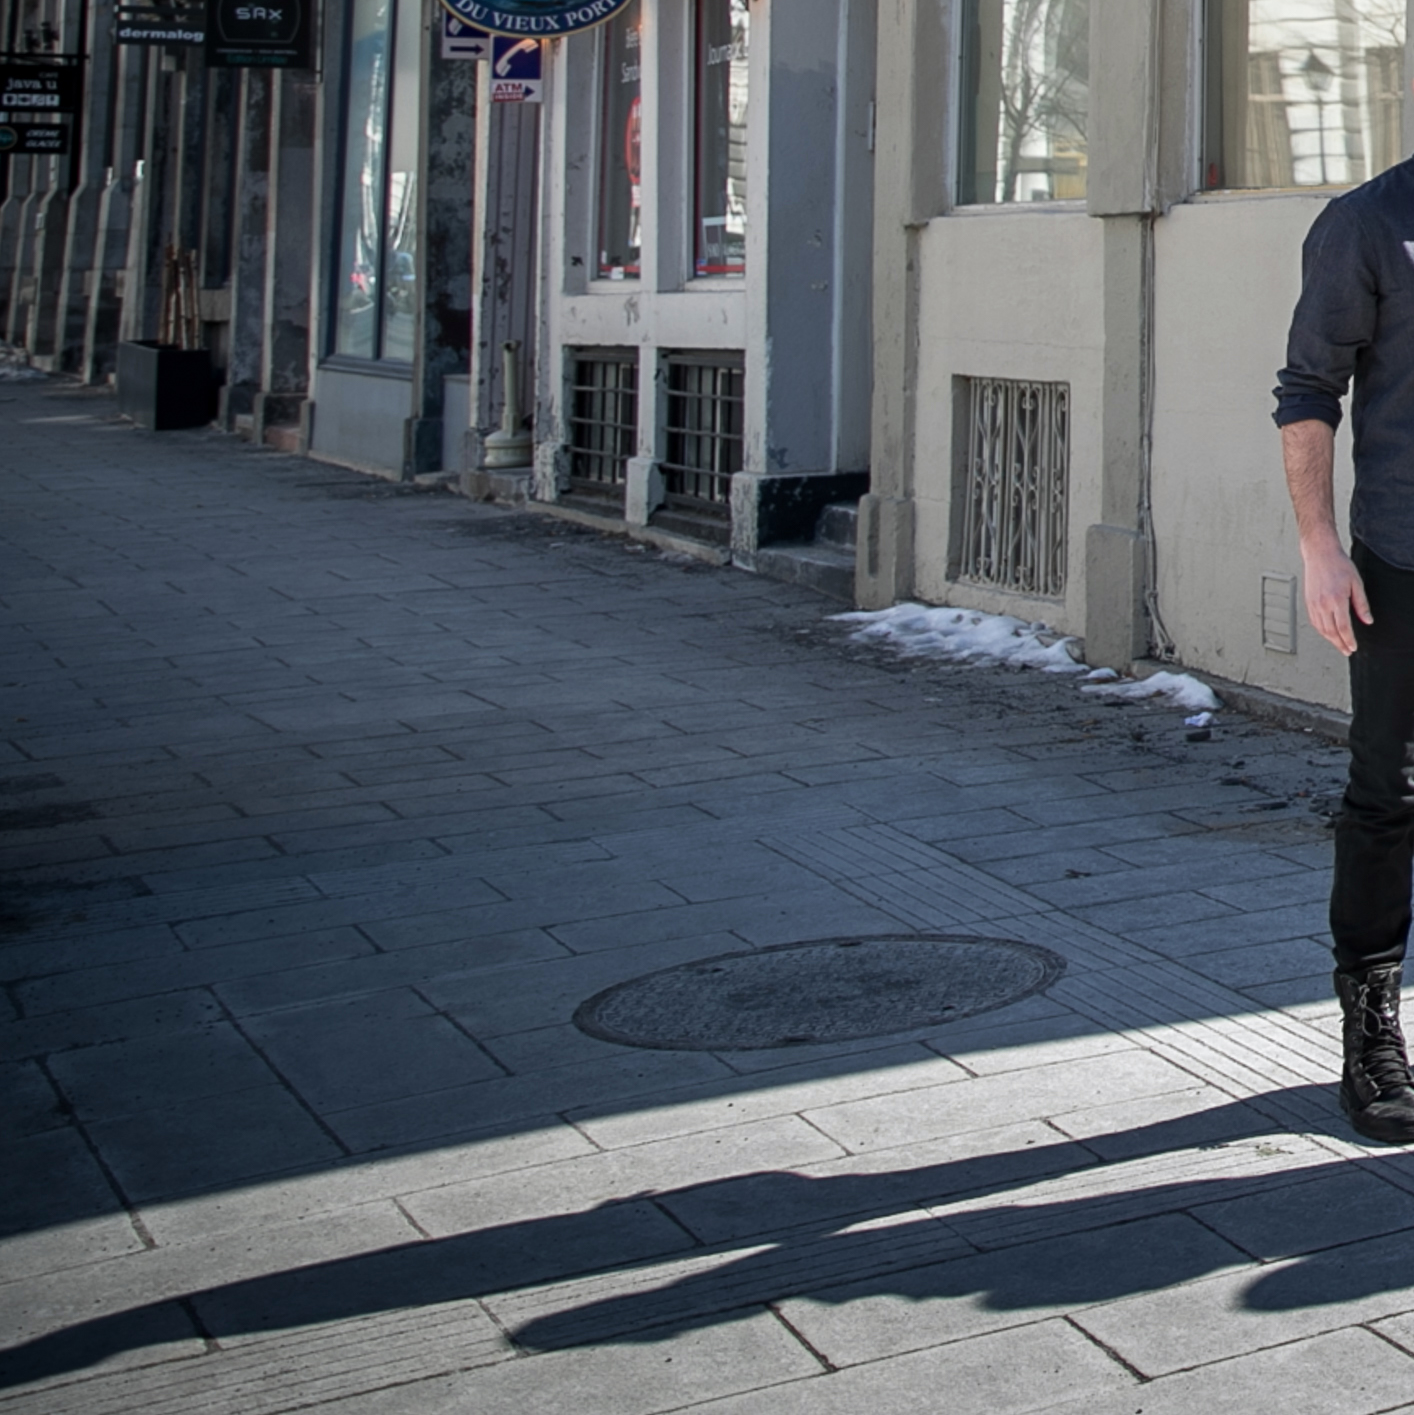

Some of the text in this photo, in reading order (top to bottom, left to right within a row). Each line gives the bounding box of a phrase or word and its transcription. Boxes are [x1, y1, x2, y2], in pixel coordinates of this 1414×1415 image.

[236, 7, 283, 20] SAX
[492, 11, 561, 31] VIEUX
[119, 27, 204, 42] dermalog
[6, 77, 42, 91] java
[495, 83, 523, 92] ATM
